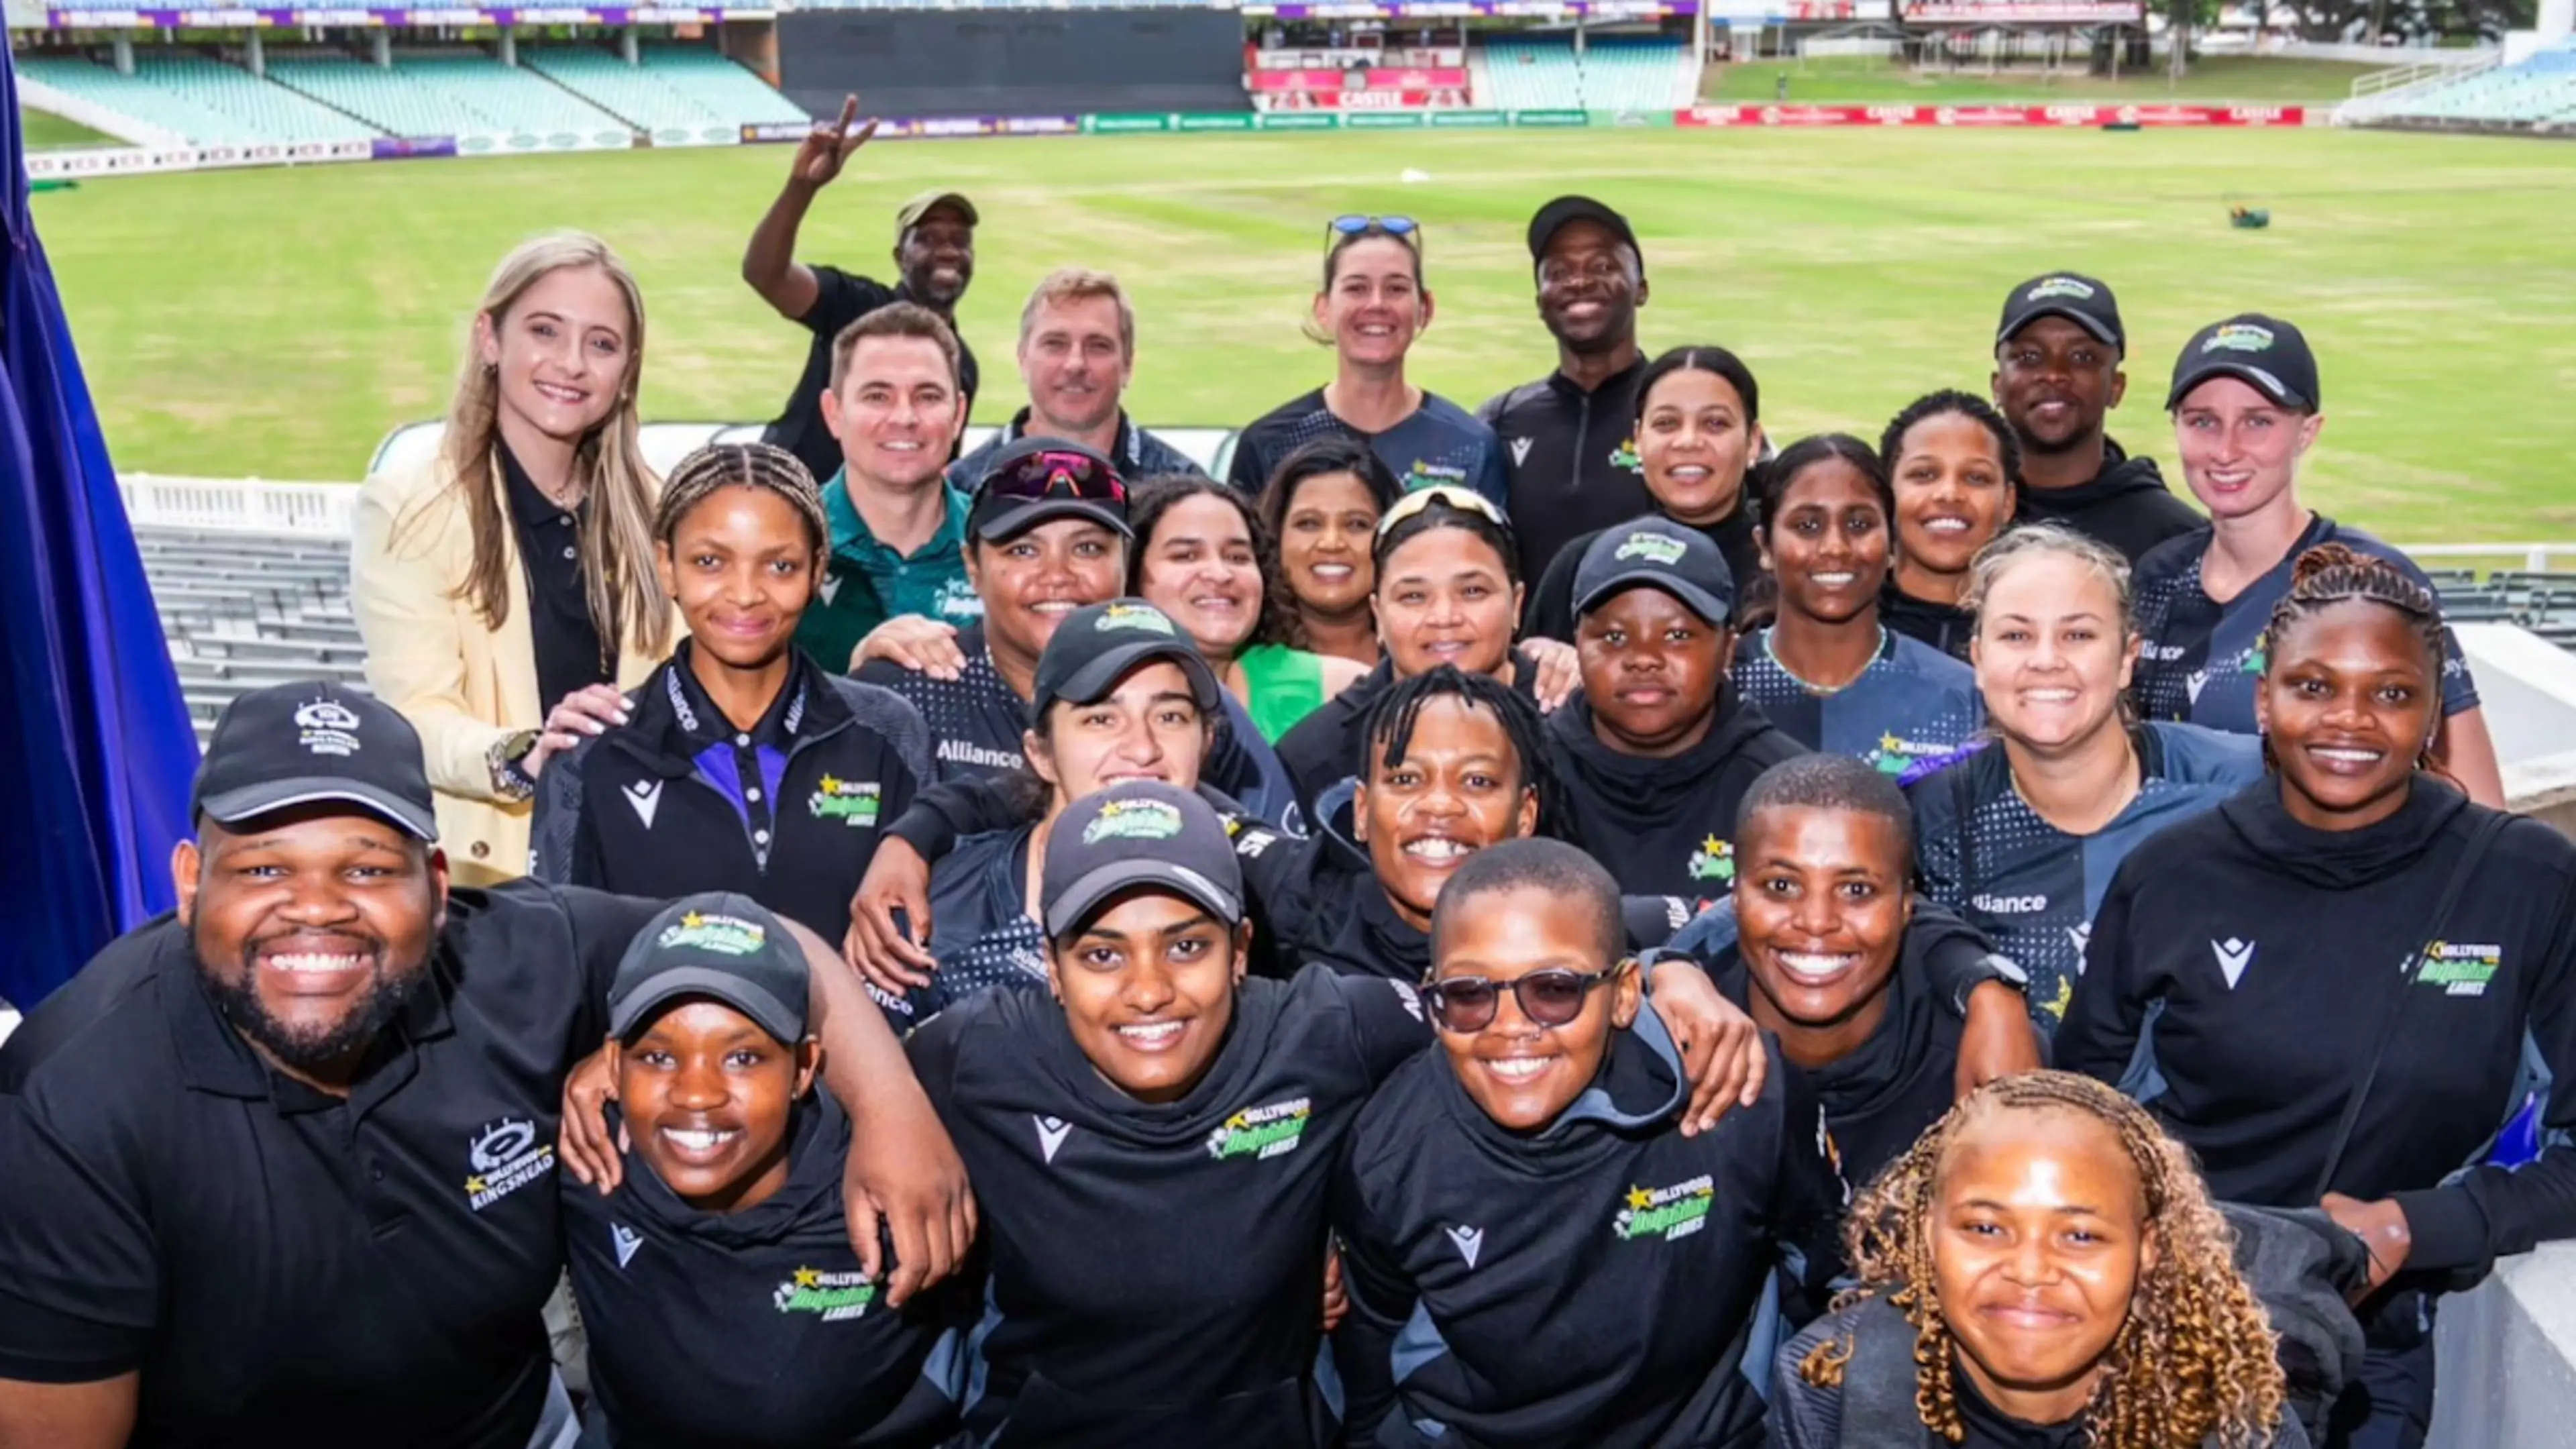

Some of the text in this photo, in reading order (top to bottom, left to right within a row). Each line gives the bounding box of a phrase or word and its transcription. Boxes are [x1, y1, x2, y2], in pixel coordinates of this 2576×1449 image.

[937, 739, 1024, 769] Alliance
[1244, 1097, 1311, 1124] HOLLYWOOD
[470, 1154, 555, 1211] KINGSMEAD
[1650, 1174, 1714, 1205] HOLLYWOOD
